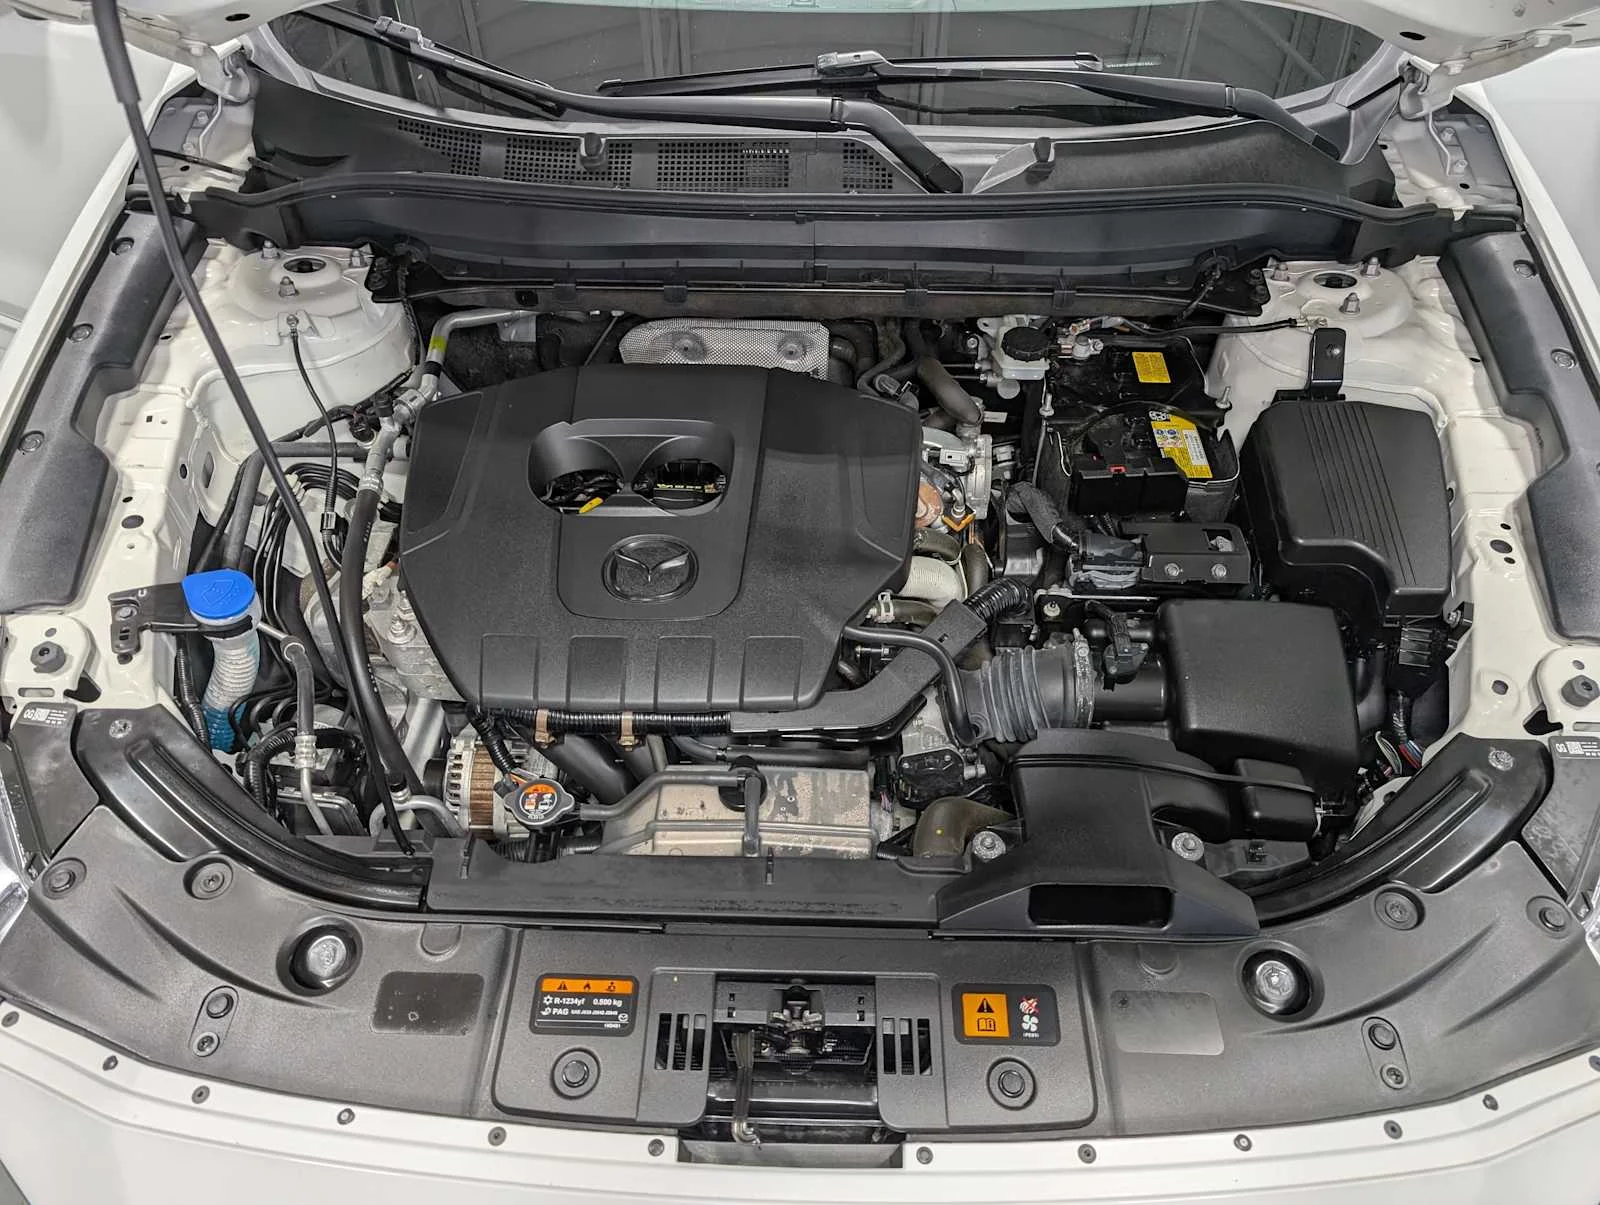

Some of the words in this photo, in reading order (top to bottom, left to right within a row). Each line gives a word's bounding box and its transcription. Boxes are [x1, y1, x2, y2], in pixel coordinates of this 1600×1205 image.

[554, 997, 585, 1006] R-1234yf
[613, 999, 623, 1008] kg
[552, 1007, 569, 1015] PAG
